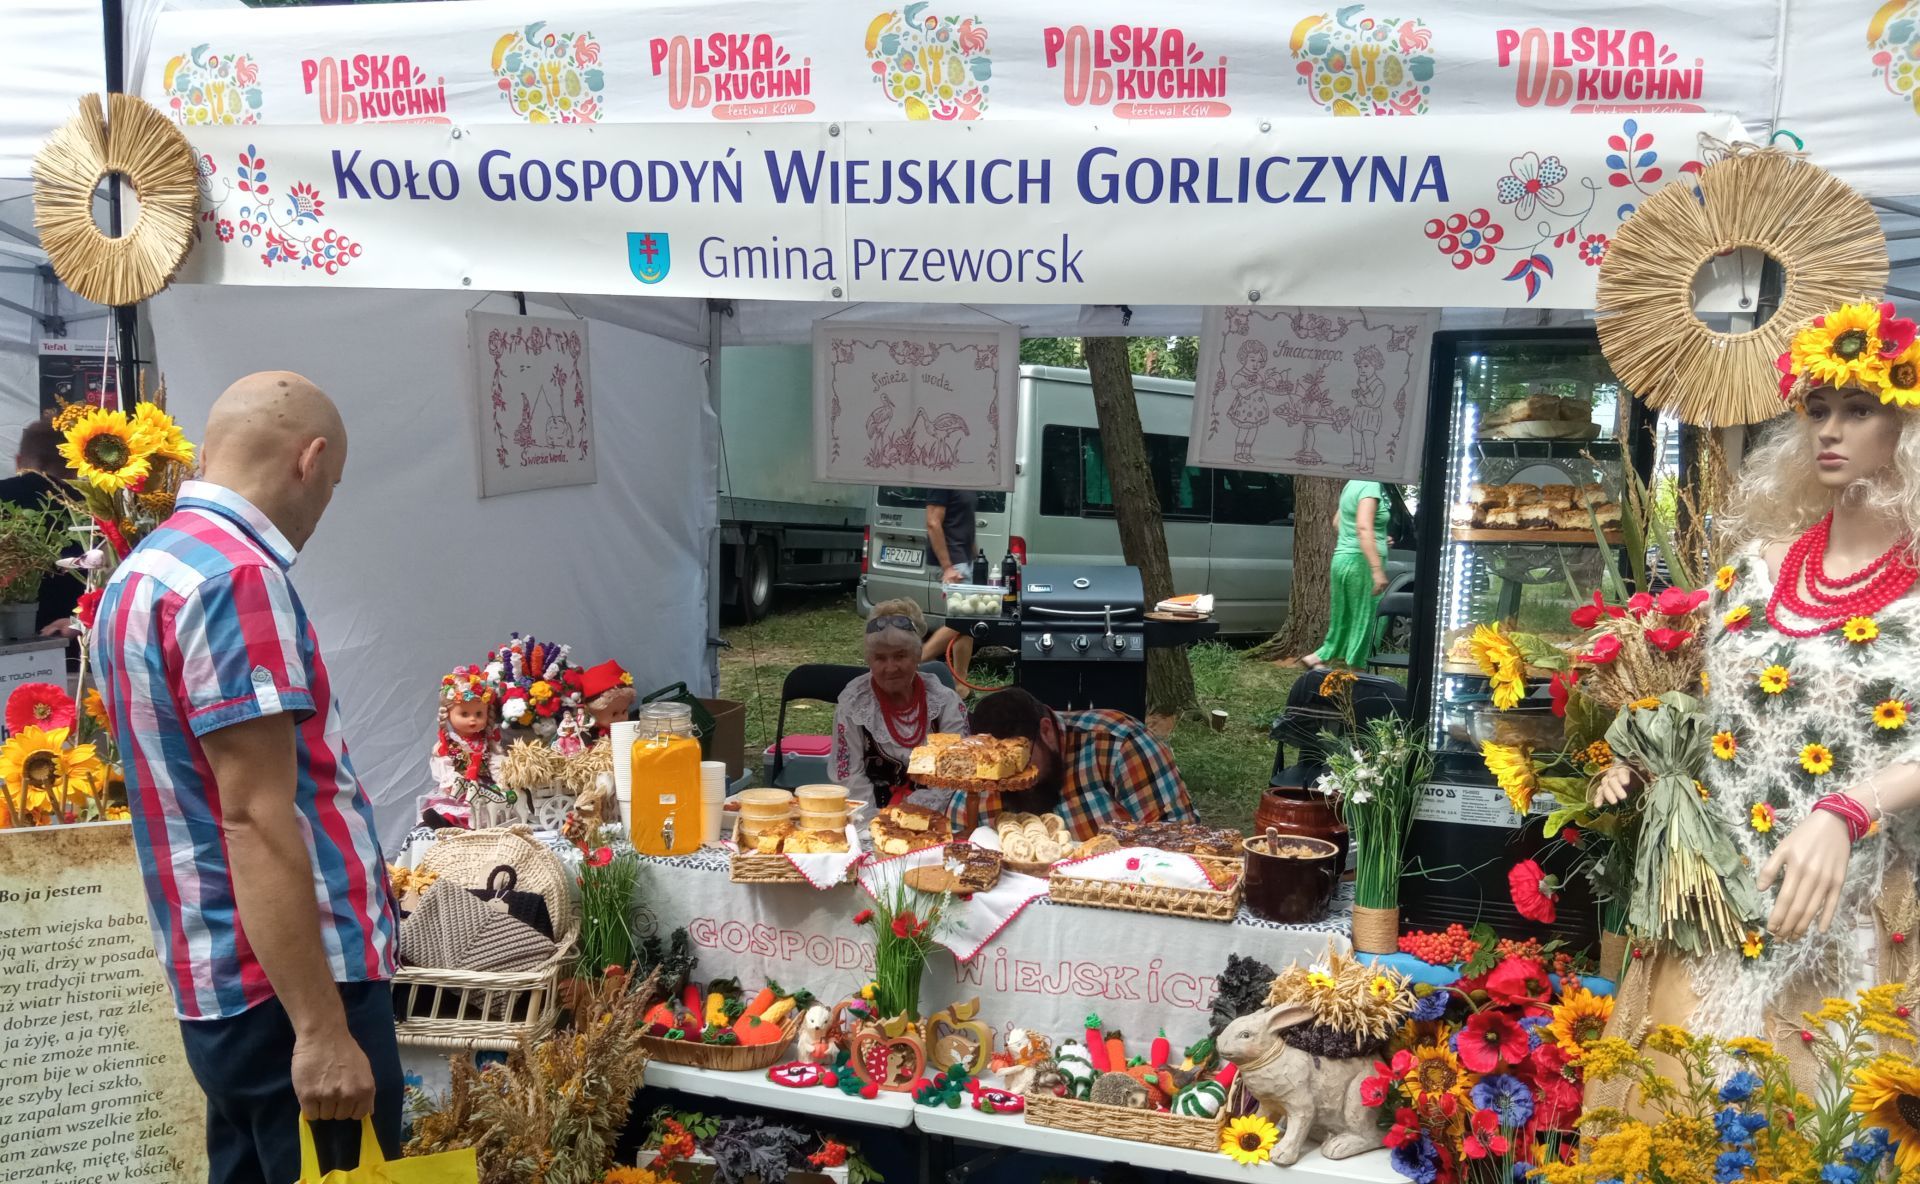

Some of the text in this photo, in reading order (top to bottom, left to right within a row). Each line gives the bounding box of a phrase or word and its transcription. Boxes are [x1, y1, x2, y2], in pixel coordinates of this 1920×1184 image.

[650, 32, 774, 86] POLSKA
[1044, 25, 1184, 80] POLSKA
[1496, 27, 1656, 79] POLSKA
[302, 54, 412, 102] POLSKA
[727, 103, 797, 117] festiwal KGW
[1131, 102, 1210, 118] festiwal KGW
[331, 146, 1451, 206] KOŁO GOSPODYŃ WIEJSKICH GORLICZYNA
[699, 233, 1086, 285] Gmina Przeworsk
[43, 342, 69, 352] Tefal
[24, 886, 40, 904] ja
[45, 884, 102, 903] jestem
[0, 912, 148, 940] stem wiejska baba,
[0, 934, 134, 961] ją wartość znam,
[3, 946, 159, 976] wali, drży w posada
[26, 972, 86, 992] tradycji
[90, 967, 144, 983] trwam.
[20, 994, 62, 1011] wiatr
[66, 985, 122, 1005] historii
[126, 980, 165, 998] wieje
[4, 1000, 153, 1031] dobrze jest, raz źle,
[4, 1022, 130, 1051] ja żyję, a ja tyję,
[13, 1053, 37, 1068] nie
[42, 1045, 93, 1064] zmoże
[98, 1039, 139, 1055] mnie.
[44, 1066, 71, 1083] bije
[76, 1066, 89, 1077] w
[93, 1053, 167, 1074] okiennice
[18, 1086, 63, 1106] szyby
[68, 1079, 94, 1096] leci
[99, 1074, 142, 1091] szkło,
[18, 1102, 86, 1124] zapalam
[91, 1089, 164, 1115] gromnice
[66, 1112, 132, 1134] wszelkie
[136, 1107, 162, 1122] zło.
[31, 1139, 88, 1158] zawsze
[92, 1130, 135, 1152] polne
[139, 1121, 177, 1141] ziele,
[83, 1150, 130, 1169] miętę,
[135, 1144, 169, 1160] ślaz,
[107, 1171, 120, 1182] w
[125, 1157, 185, 1179] kościele
